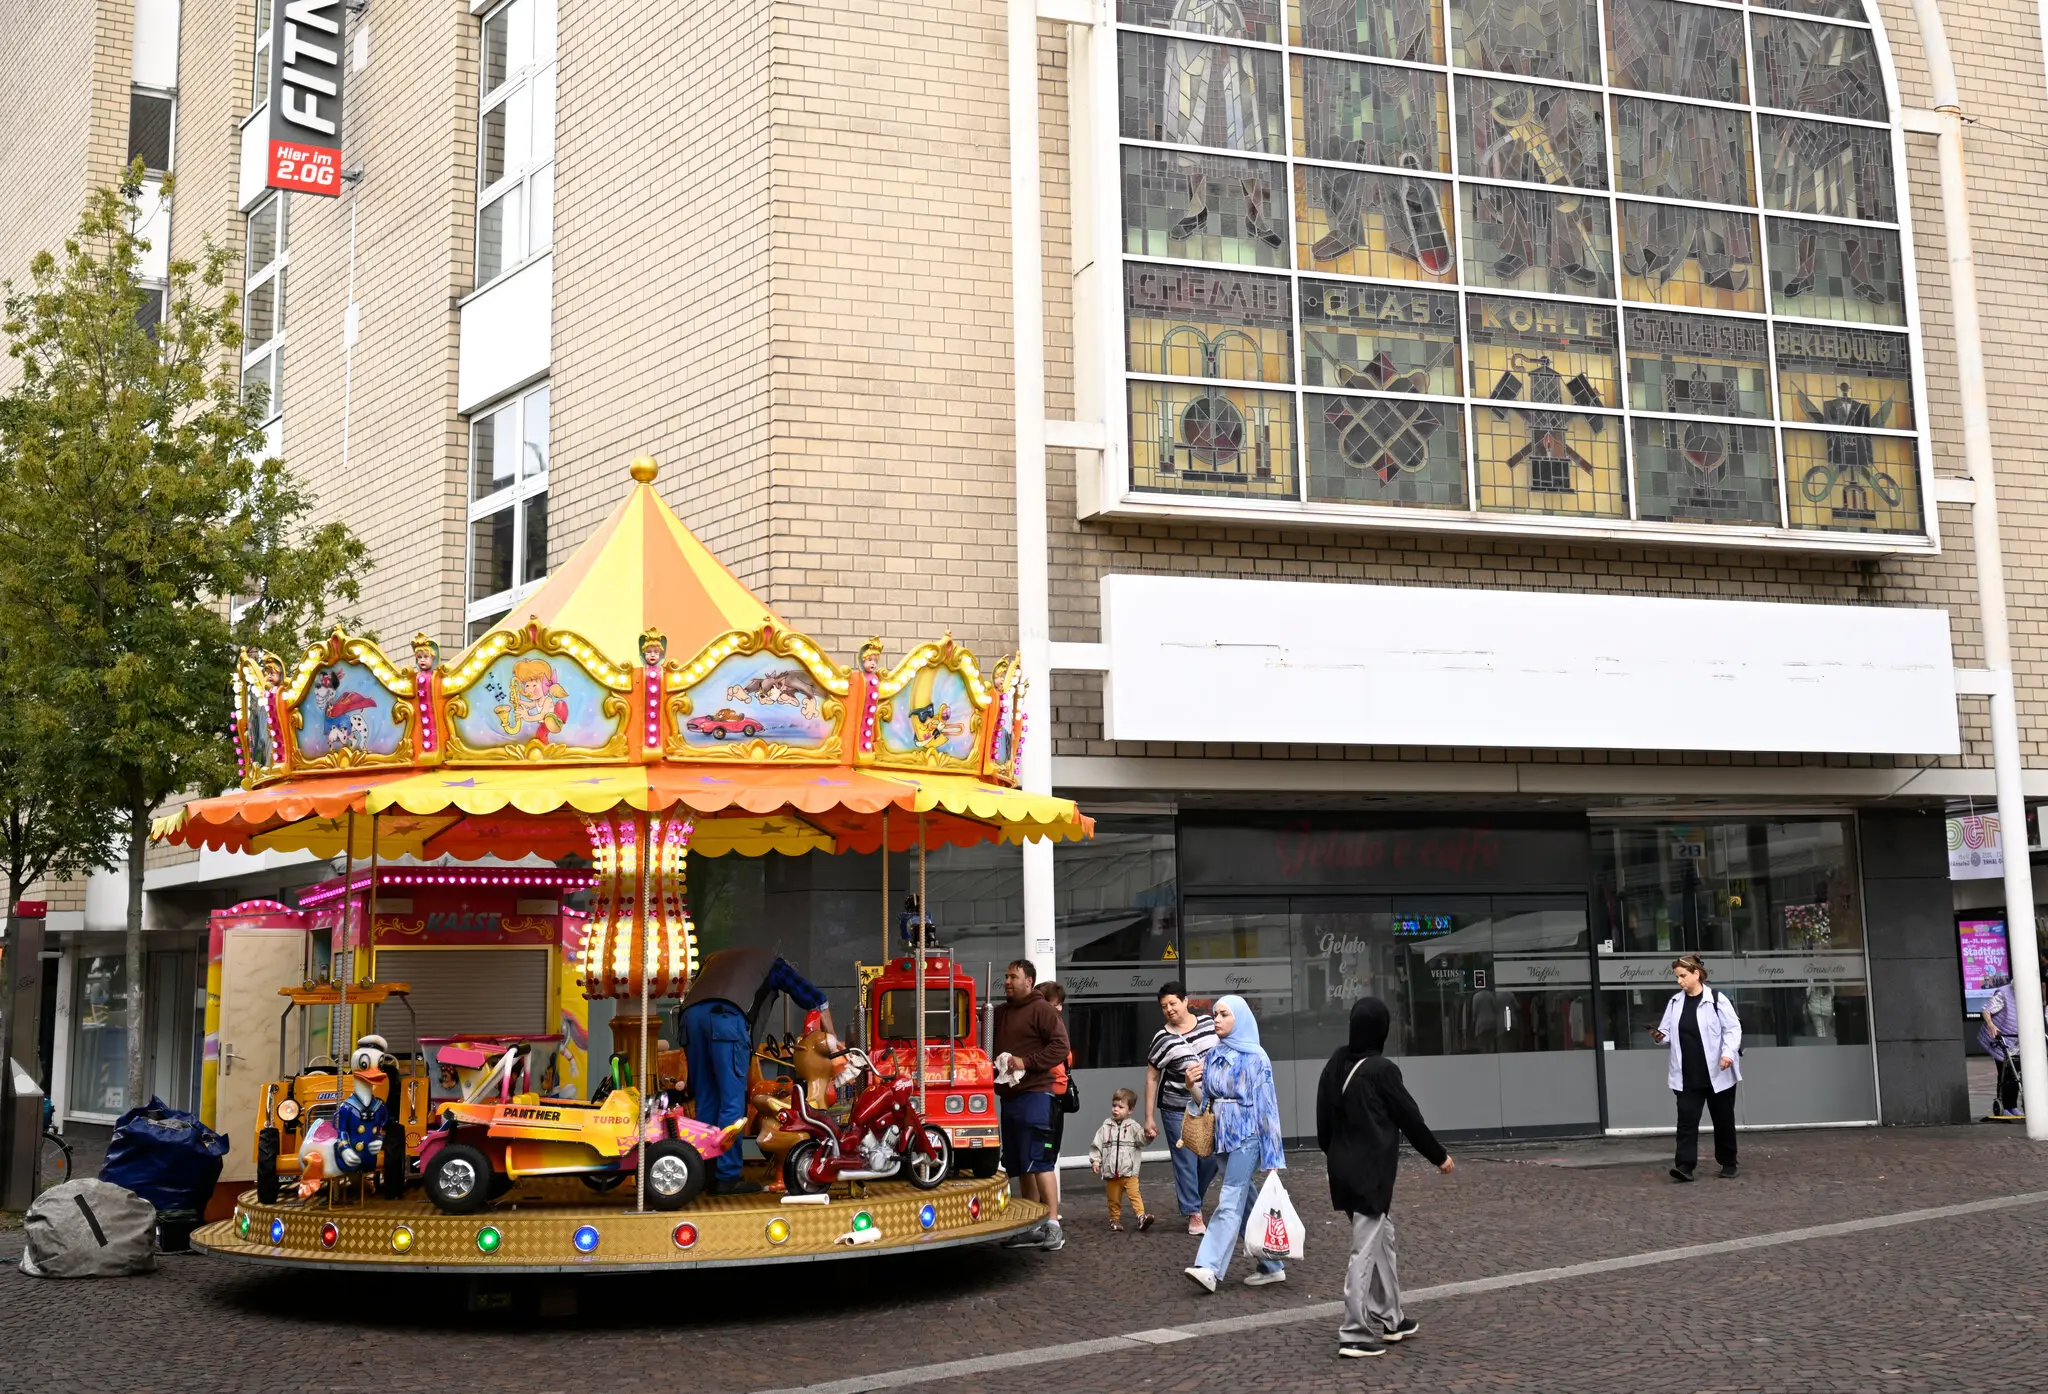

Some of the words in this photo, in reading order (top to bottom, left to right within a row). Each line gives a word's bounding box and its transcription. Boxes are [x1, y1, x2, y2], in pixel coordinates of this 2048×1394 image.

[277, 146, 309, 162] Hier
[313, 151, 332, 165] im
[1323, 287, 1431, 322] GLAS
[1482, 302, 1602, 336] KOHLE
[1776, 331, 1891, 363] BEKLEIDUNG
[1275, 817, 1383, 878] Gelato
[1393, 838, 1412, 868] e
[426, 912, 502, 932] KASSE
[1319, 932, 1366, 959] Gelato
[1963, 945, 2006, 957] Stadtfest
[1339, 960, 1348, 974] e
[1984, 955, 2003, 966] City
[1431, 969, 1460, 978] VELTINS
[1526, 966, 1561, 982] Waffeln
[1065, 975, 1099, 993] Waffeln
[503, 1107, 562, 1122] PANTHER
[593, 1115, 631, 1125] TURBO
